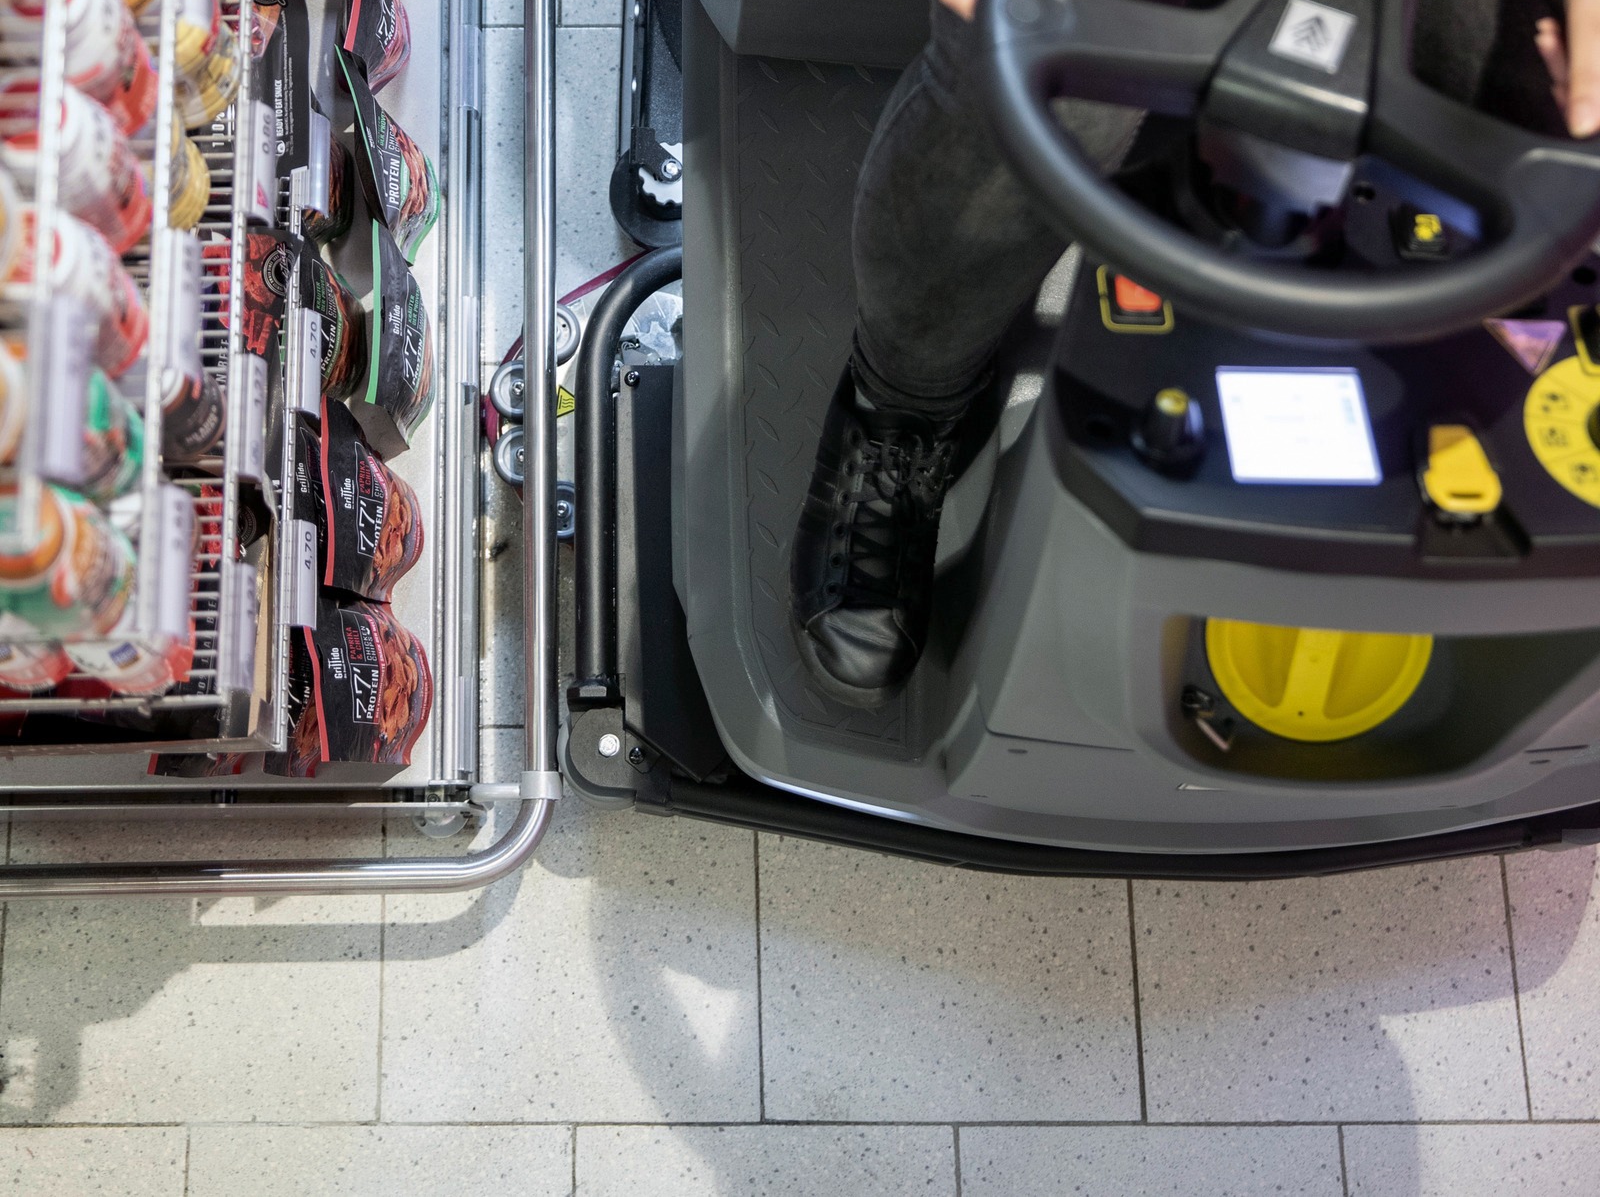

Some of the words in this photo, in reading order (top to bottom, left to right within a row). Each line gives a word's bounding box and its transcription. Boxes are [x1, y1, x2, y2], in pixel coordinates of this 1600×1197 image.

[274, 79, 283, 98] SNACK
[274, 98, 283, 109] EAT
[275, 109, 283, 118] TO
[275, 118, 284, 137] READY
[388, 158, 400, 205] PROTEIN
[309, 321, 318, 359] 4,70
[320, 324, 336, 371] PROTEIN
[411, 337, 423, 386] PROTEIN
[295, 462, 308, 493] Grillido
[358, 460, 366, 493] PAPRIKA
[365, 487, 371, 495] &
[340, 478, 352, 509] Grillido
[304, 531, 312, 570] 4,70
[345, 627, 357, 660] PAPRIKA
[353, 629, 361, 650] CHILI
[360, 625, 373, 661] CHICKEN
[368, 636, 378, 662] CHIPS
[327, 647, 344, 679] Grillido
[366, 669, 380, 719] PROTEIN
